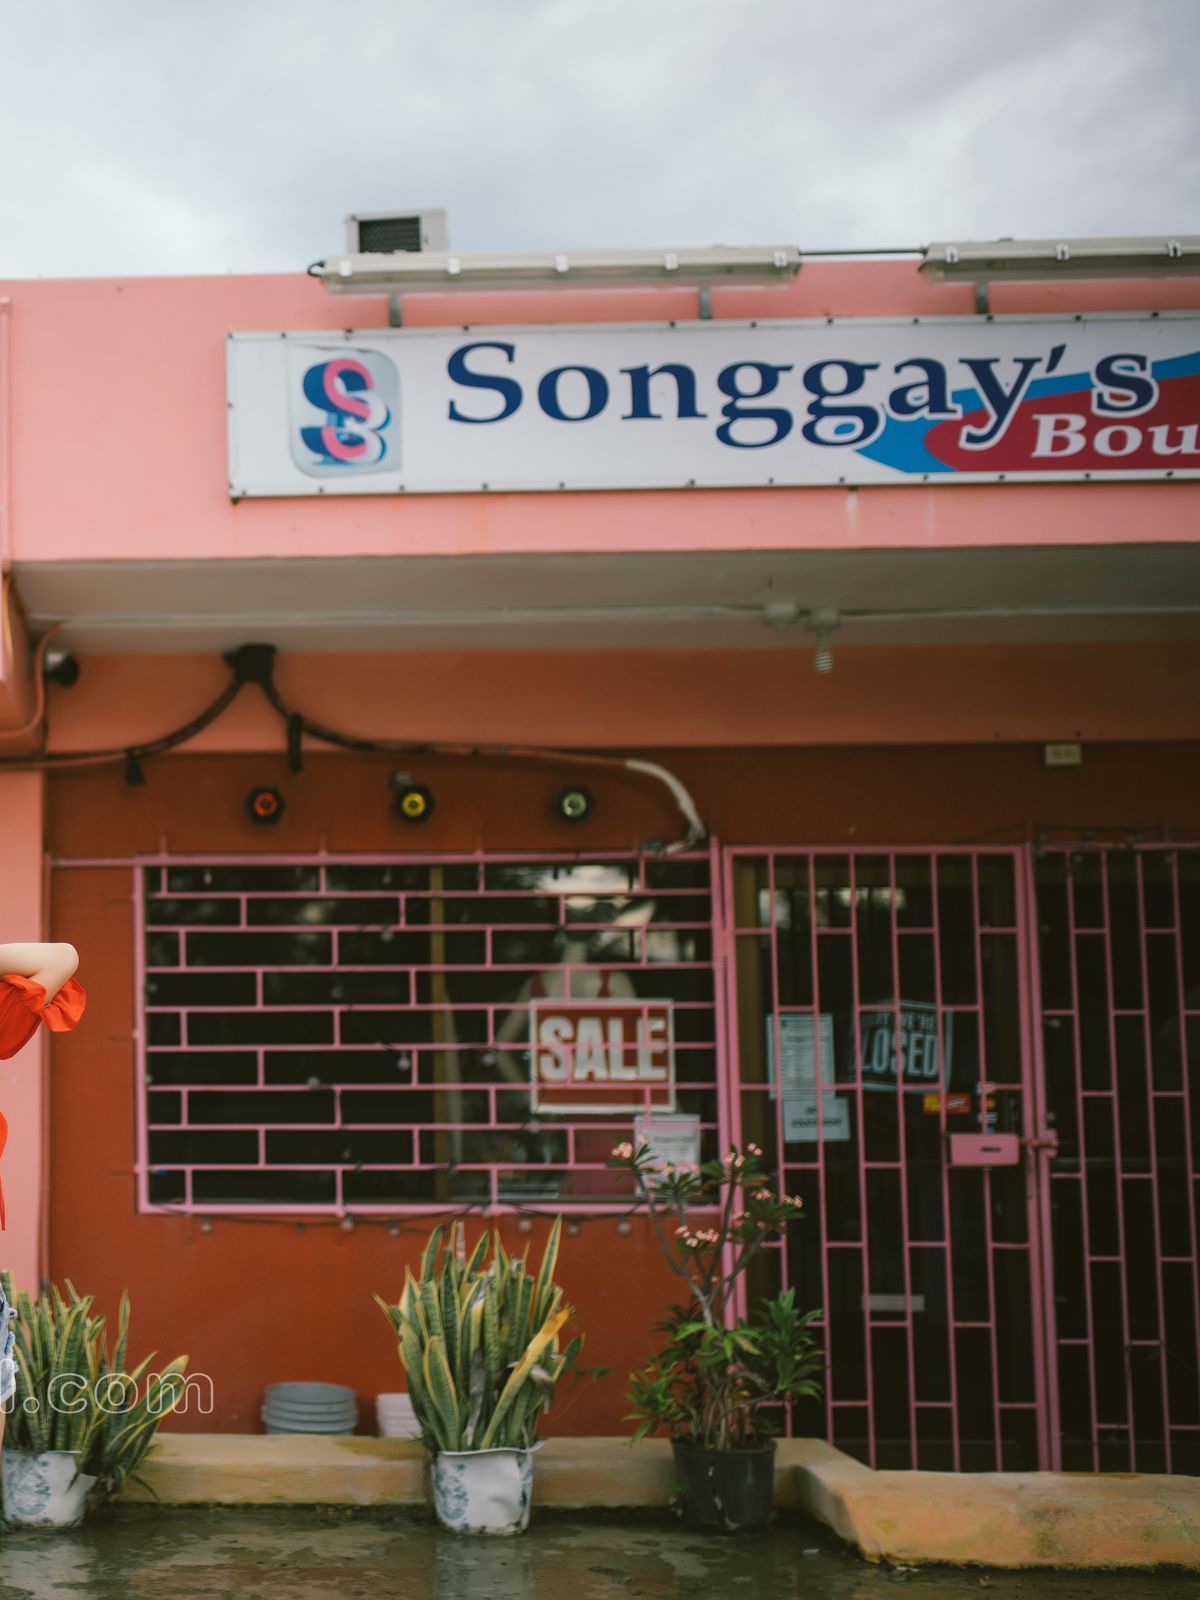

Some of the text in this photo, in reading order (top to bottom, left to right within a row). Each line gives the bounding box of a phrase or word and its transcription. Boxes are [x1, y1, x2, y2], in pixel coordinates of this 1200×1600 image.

[445, 341, 1156, 449] Songgay's
[1030, 413, 1200, 458] Bou
[539, 1016, 667, 1082] SALE
[850, 1027, 939, 1078] LOSED
